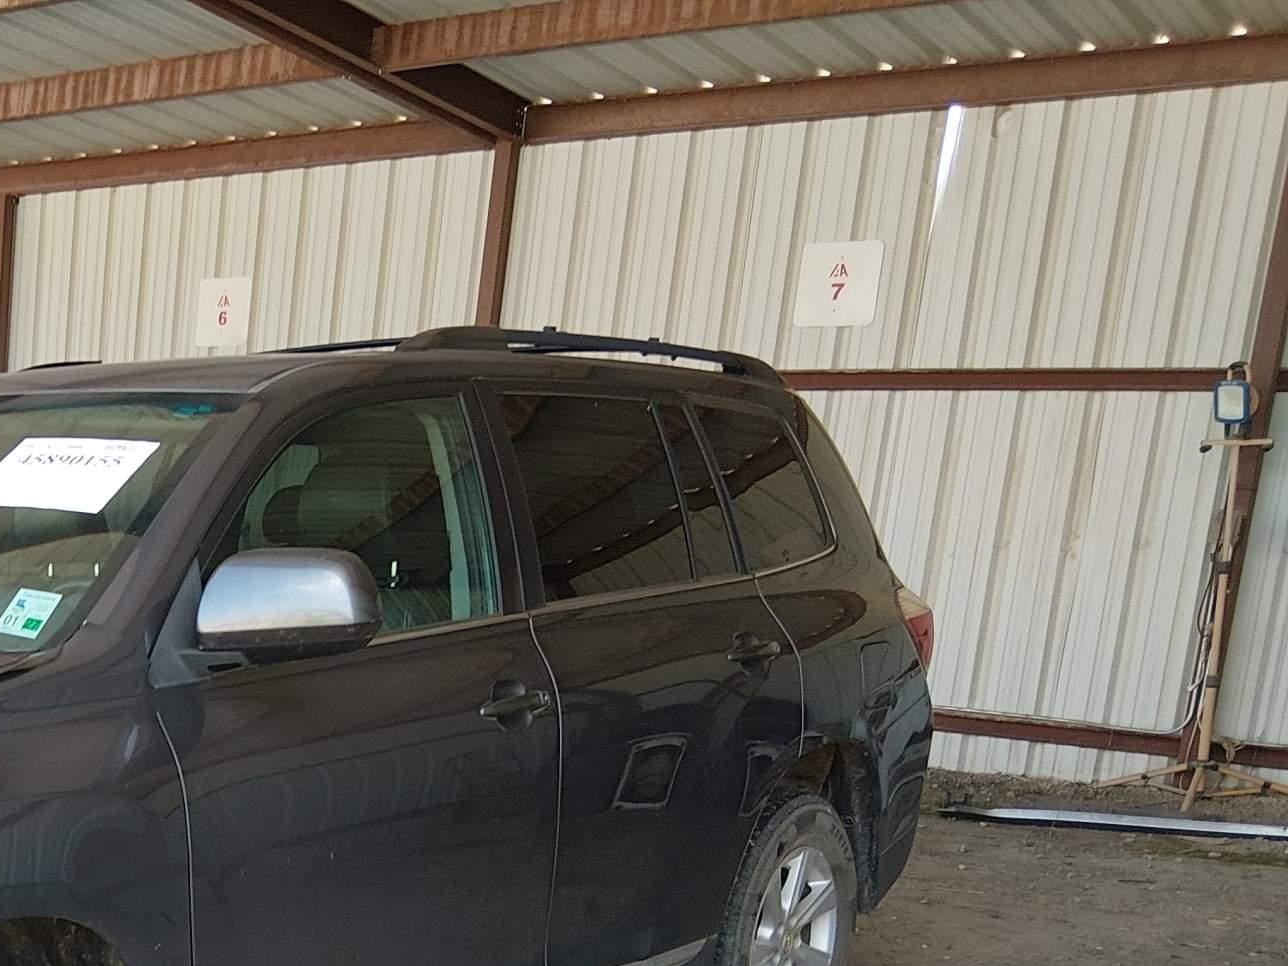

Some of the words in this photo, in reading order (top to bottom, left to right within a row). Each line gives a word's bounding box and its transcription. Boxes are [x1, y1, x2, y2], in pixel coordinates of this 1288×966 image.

[831, 283, 845, 301] 7
[217, 311, 228, 326] 6
[3, 614, 19, 626] 01
